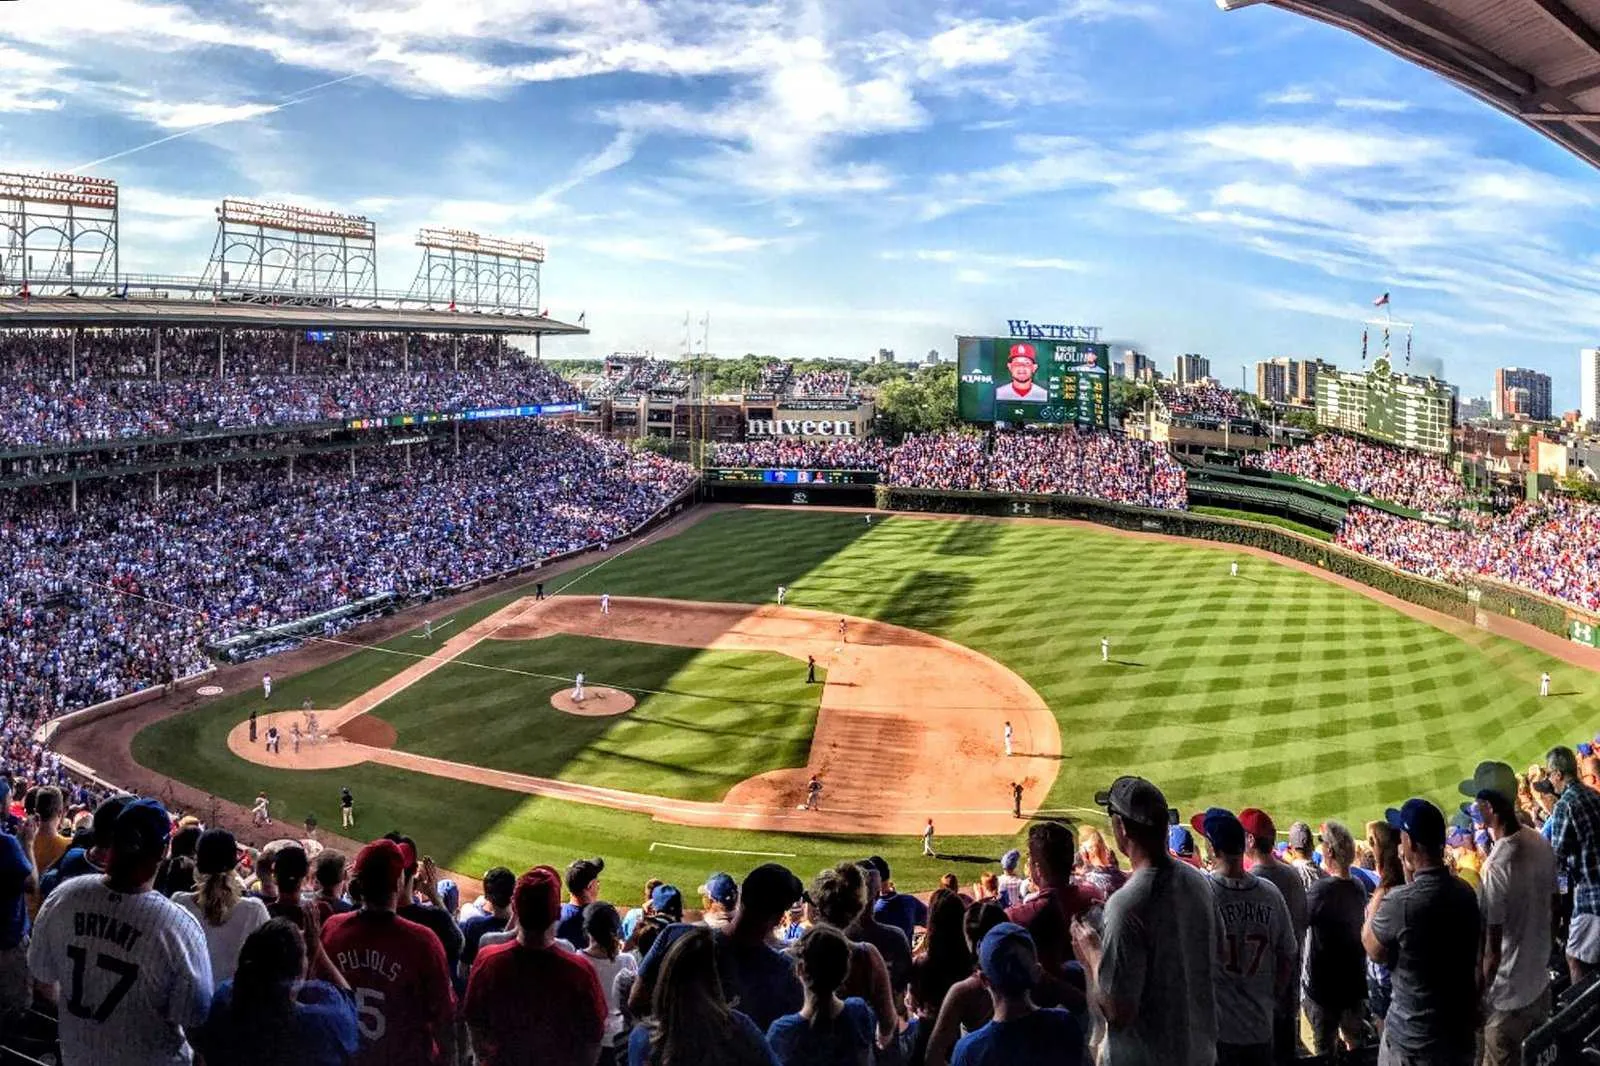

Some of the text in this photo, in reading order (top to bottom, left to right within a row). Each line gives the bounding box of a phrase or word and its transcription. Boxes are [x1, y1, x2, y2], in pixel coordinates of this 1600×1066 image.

[1054, 352, 1088, 362] MOLIN
[747, 419, 853, 435] nuveen
[74, 912, 142, 952] BRYANT
[337, 949, 401, 982] PUJOLS
[1226, 934, 1269, 976] 17
[67, 944, 139, 1022] 17
[354, 987, 386, 1040] 5
